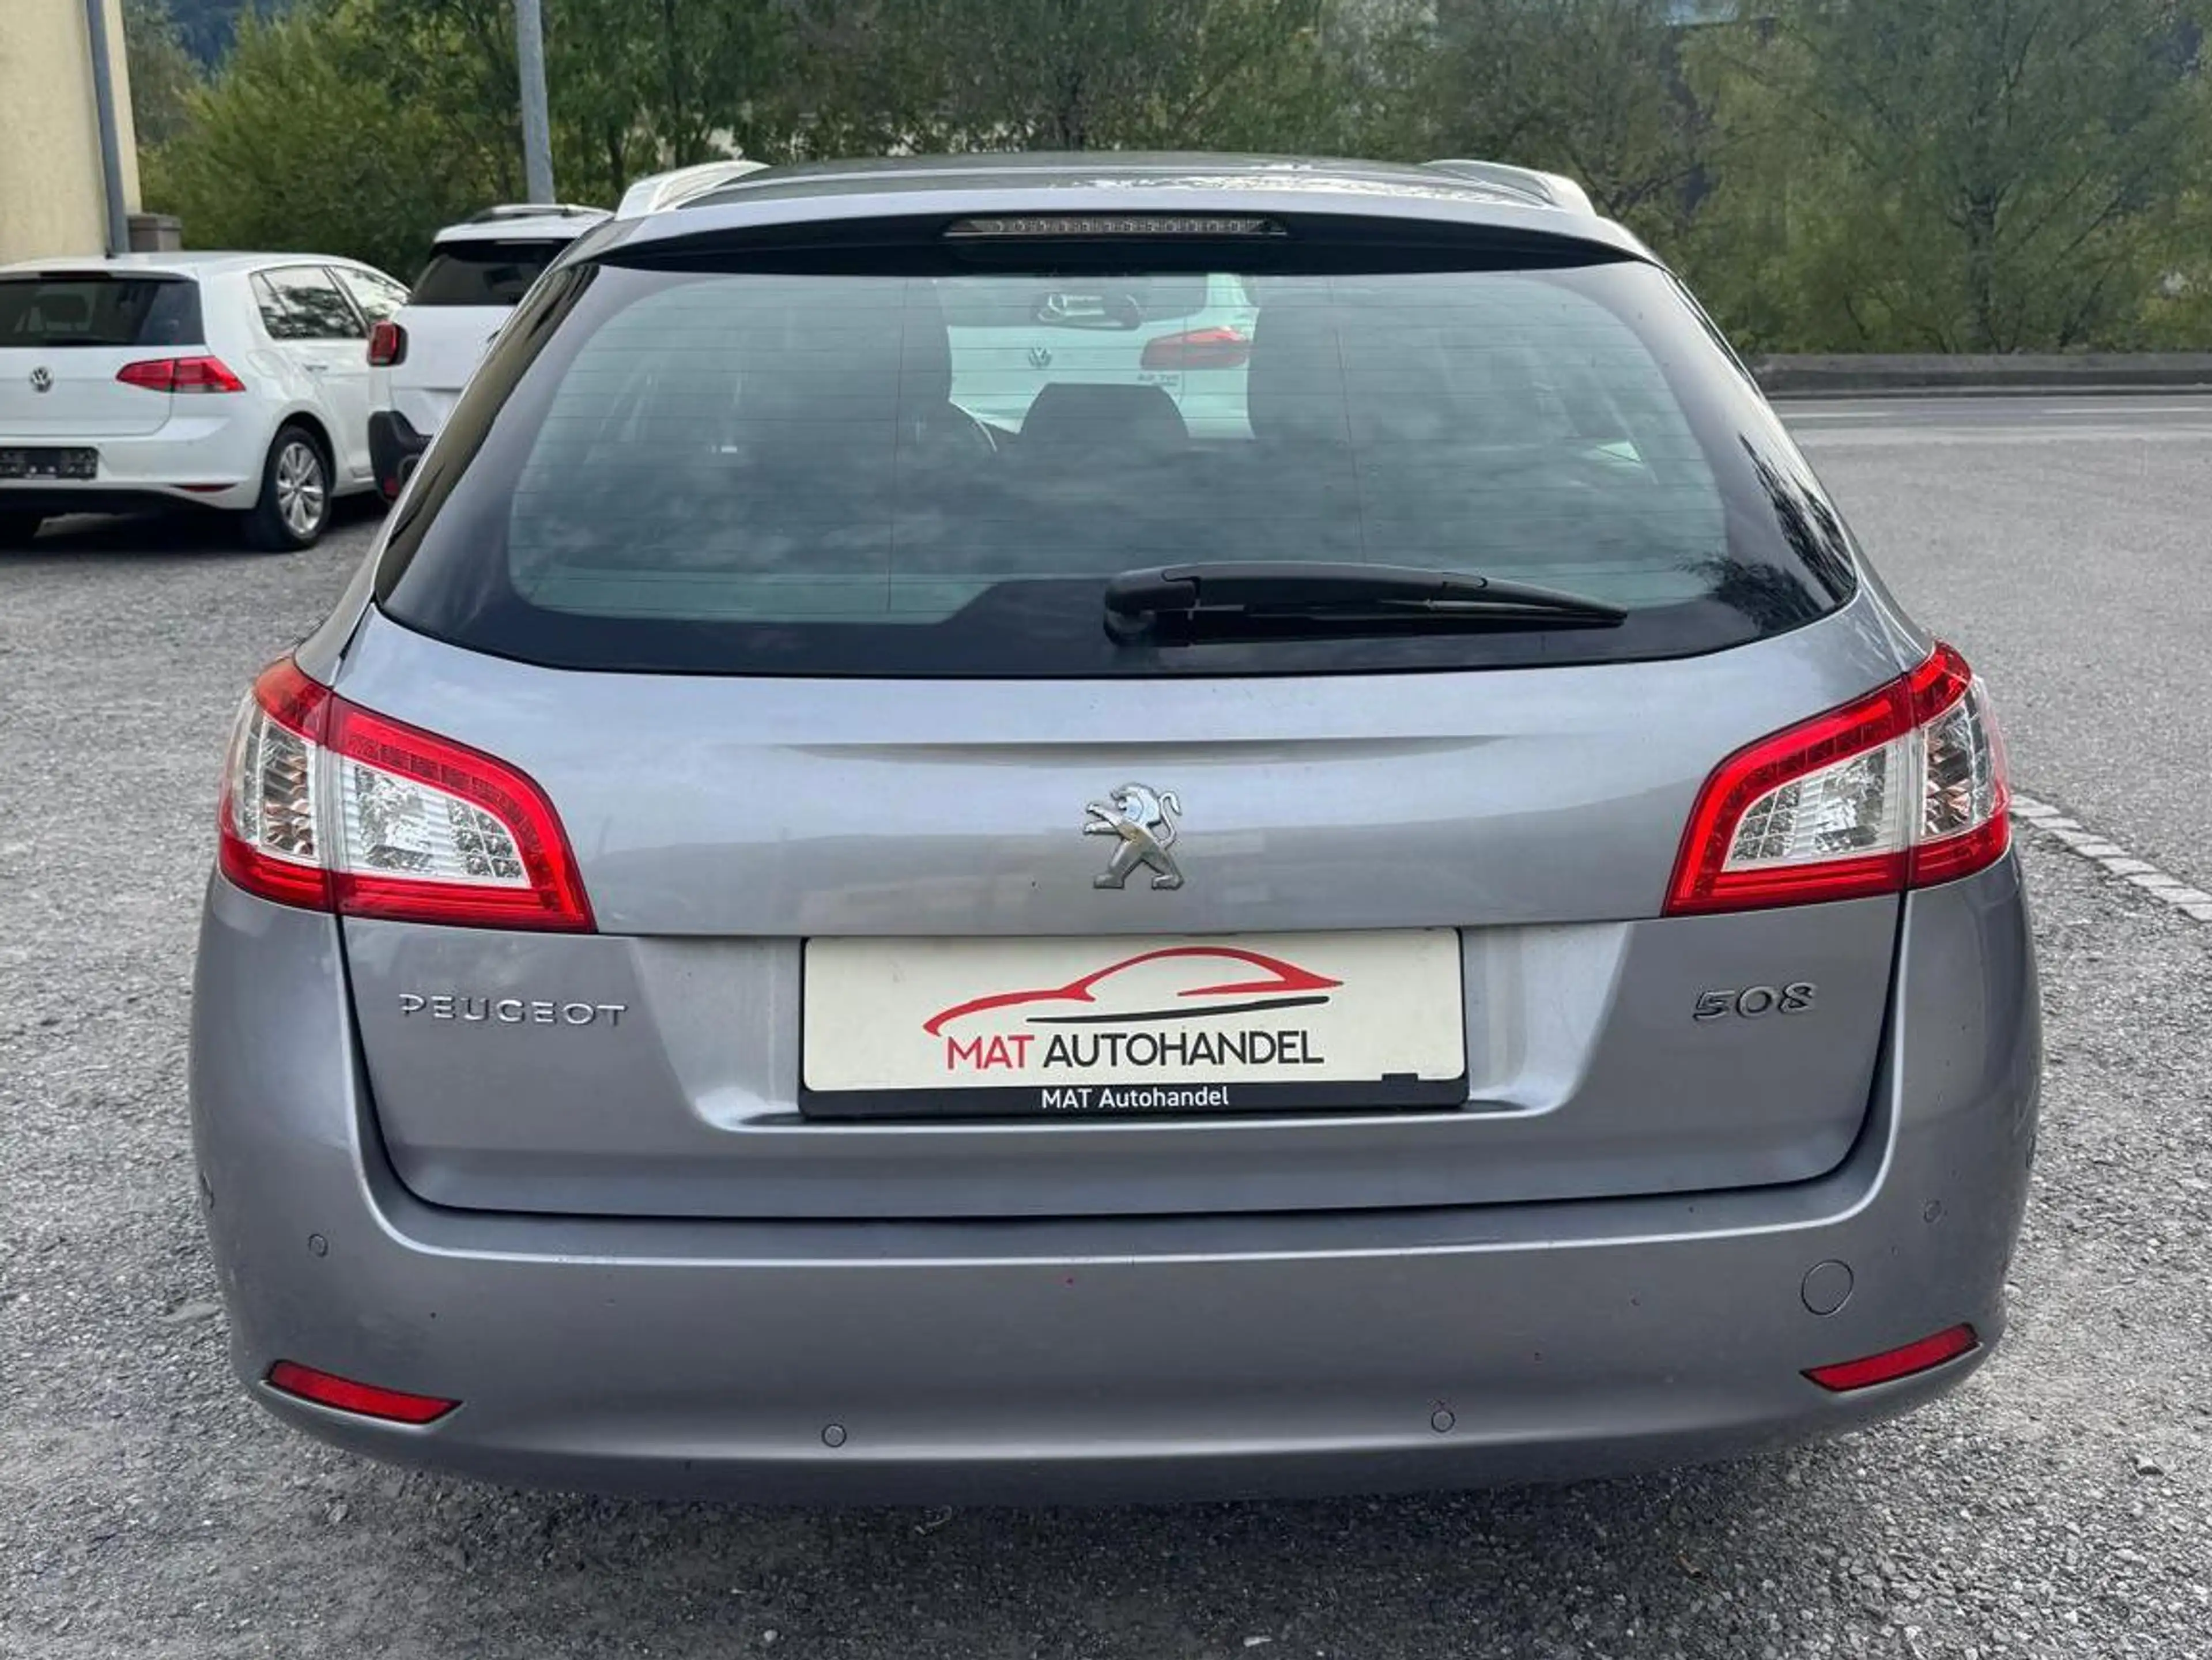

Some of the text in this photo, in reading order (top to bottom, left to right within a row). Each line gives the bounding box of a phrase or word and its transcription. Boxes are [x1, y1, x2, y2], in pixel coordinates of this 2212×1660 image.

[399, 993, 628, 1026] PEUGEOT
[1692, 982, 1817, 1021] 508
[947, 1030, 1325, 1069] MAT AUTOHANDEL
[1041, 1085, 1229, 1109] MAT Autohandel
